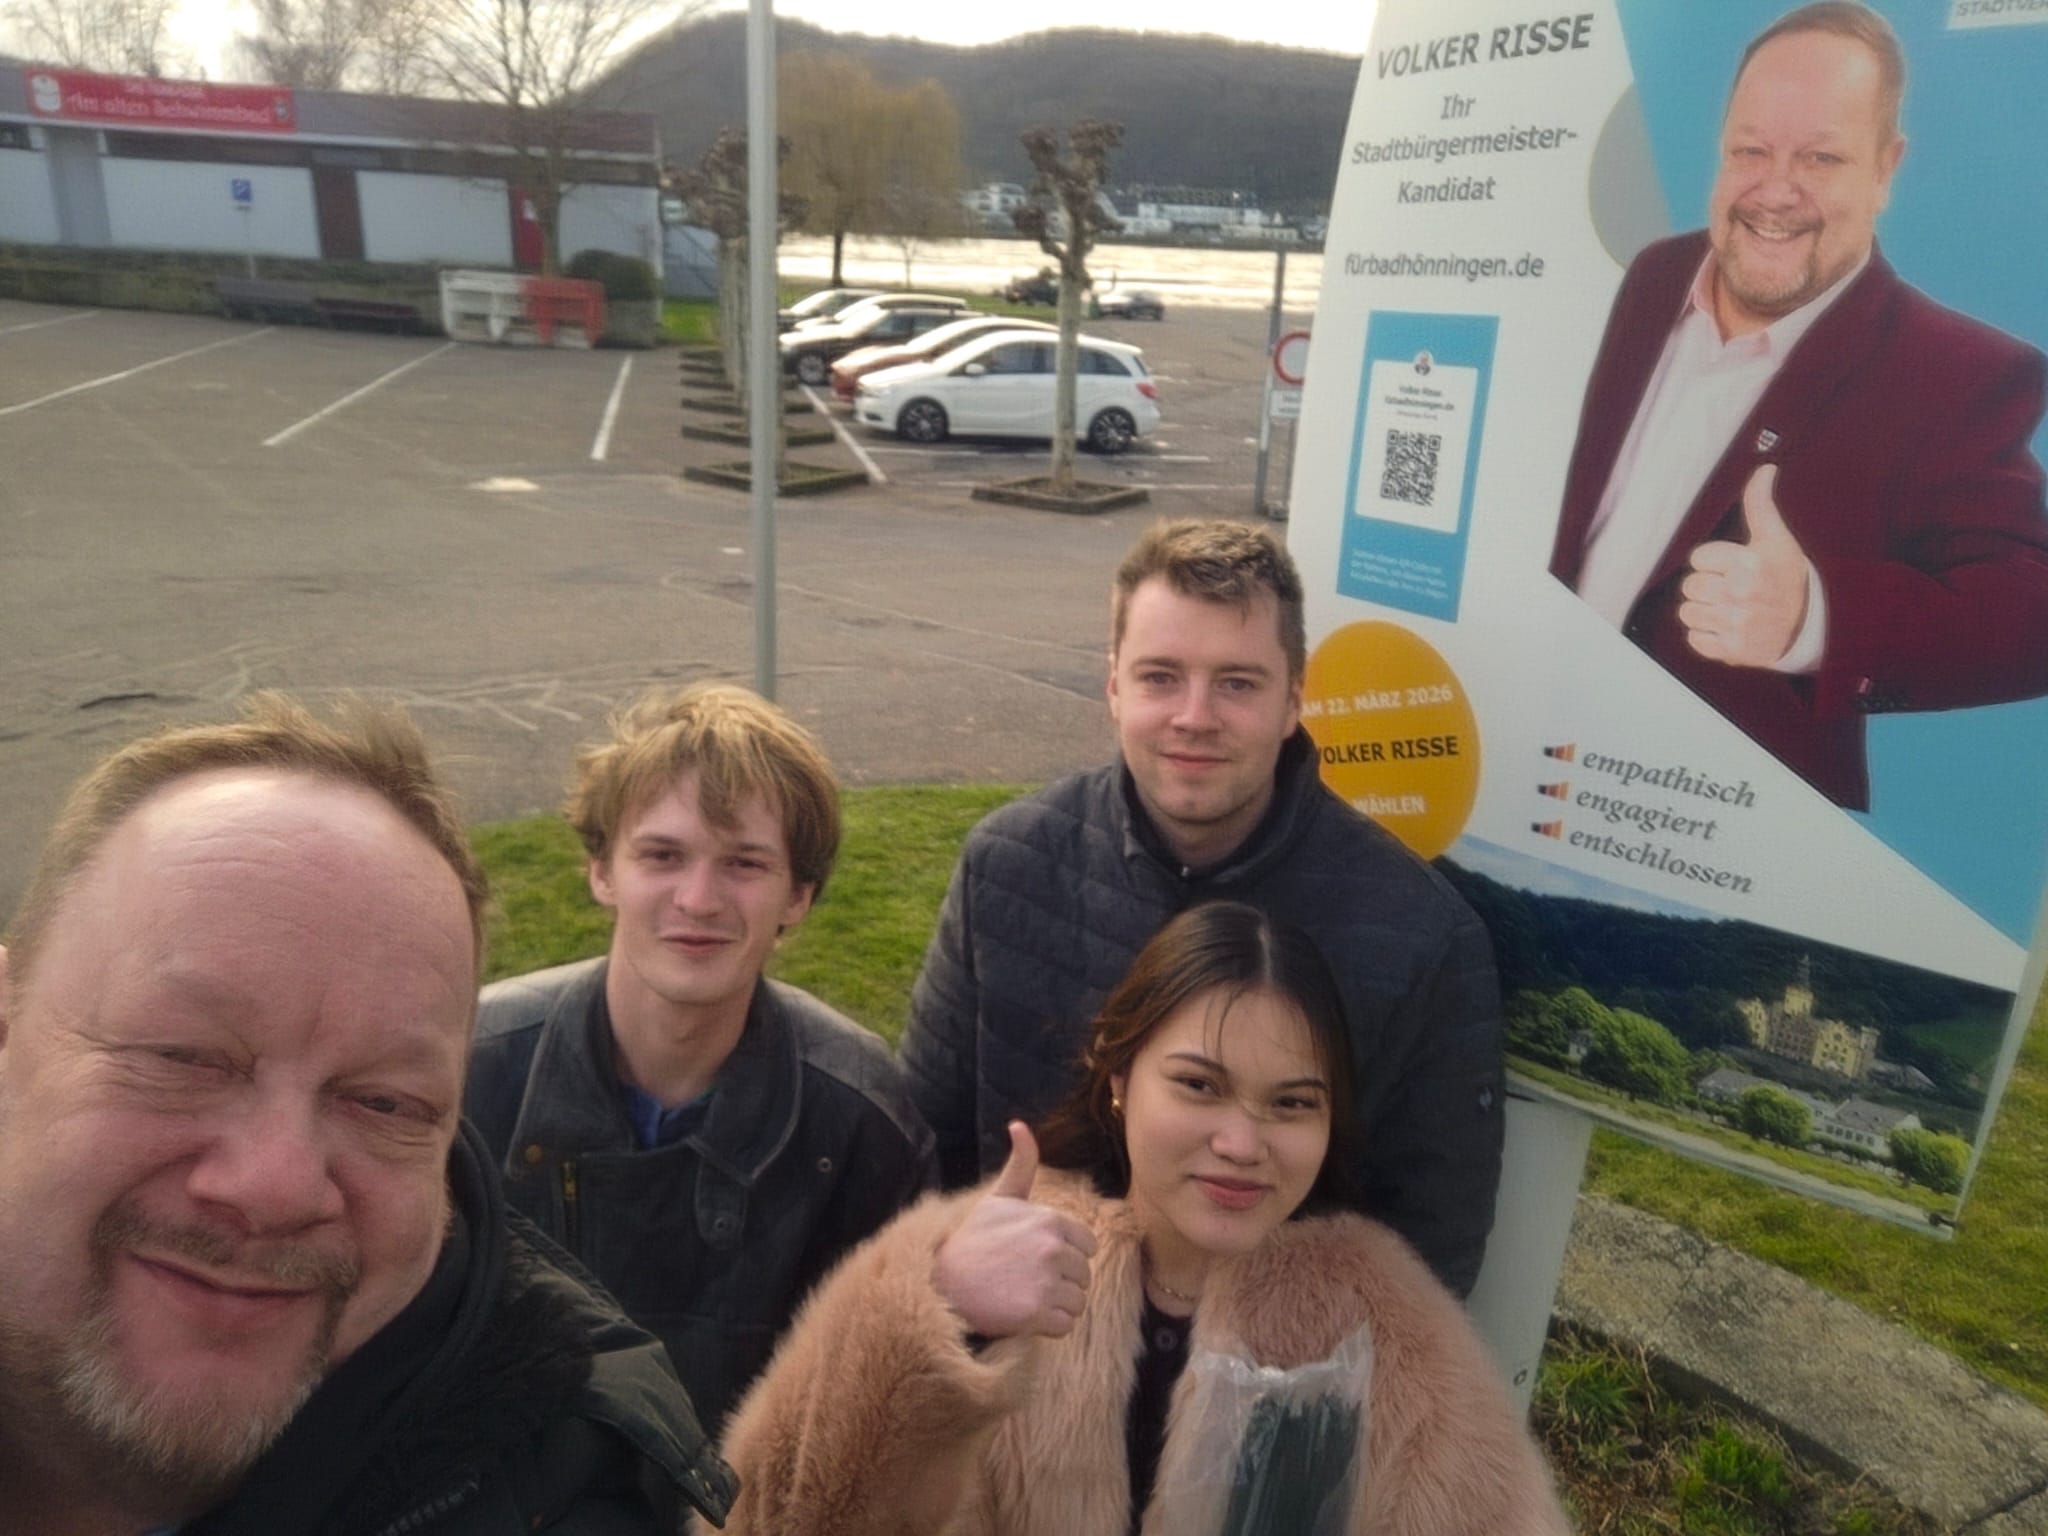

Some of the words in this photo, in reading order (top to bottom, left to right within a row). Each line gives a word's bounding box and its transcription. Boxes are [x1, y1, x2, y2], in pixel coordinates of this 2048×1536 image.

[1377, 32, 1480, 80] VOLKER
[1489, 13, 1594, 61] RISSE
[1440, 93, 1476, 120] Ihr
[1351, 125, 1578, 165] Stadtbürgermeister-
[1397, 175, 1496, 203] Kandidat
[1344, 251, 1544, 282] fürbadhönningen.de
[1356, 690, 1402, 710] MÄRZ
[1407, 684, 1453, 706] 2026
[1391, 736, 1459, 759] RISSE
[1582, 751, 1756, 808] empathisch
[1576, 788, 1718, 841] engagiert
[1569, 828, 1754, 893] entschlossen
